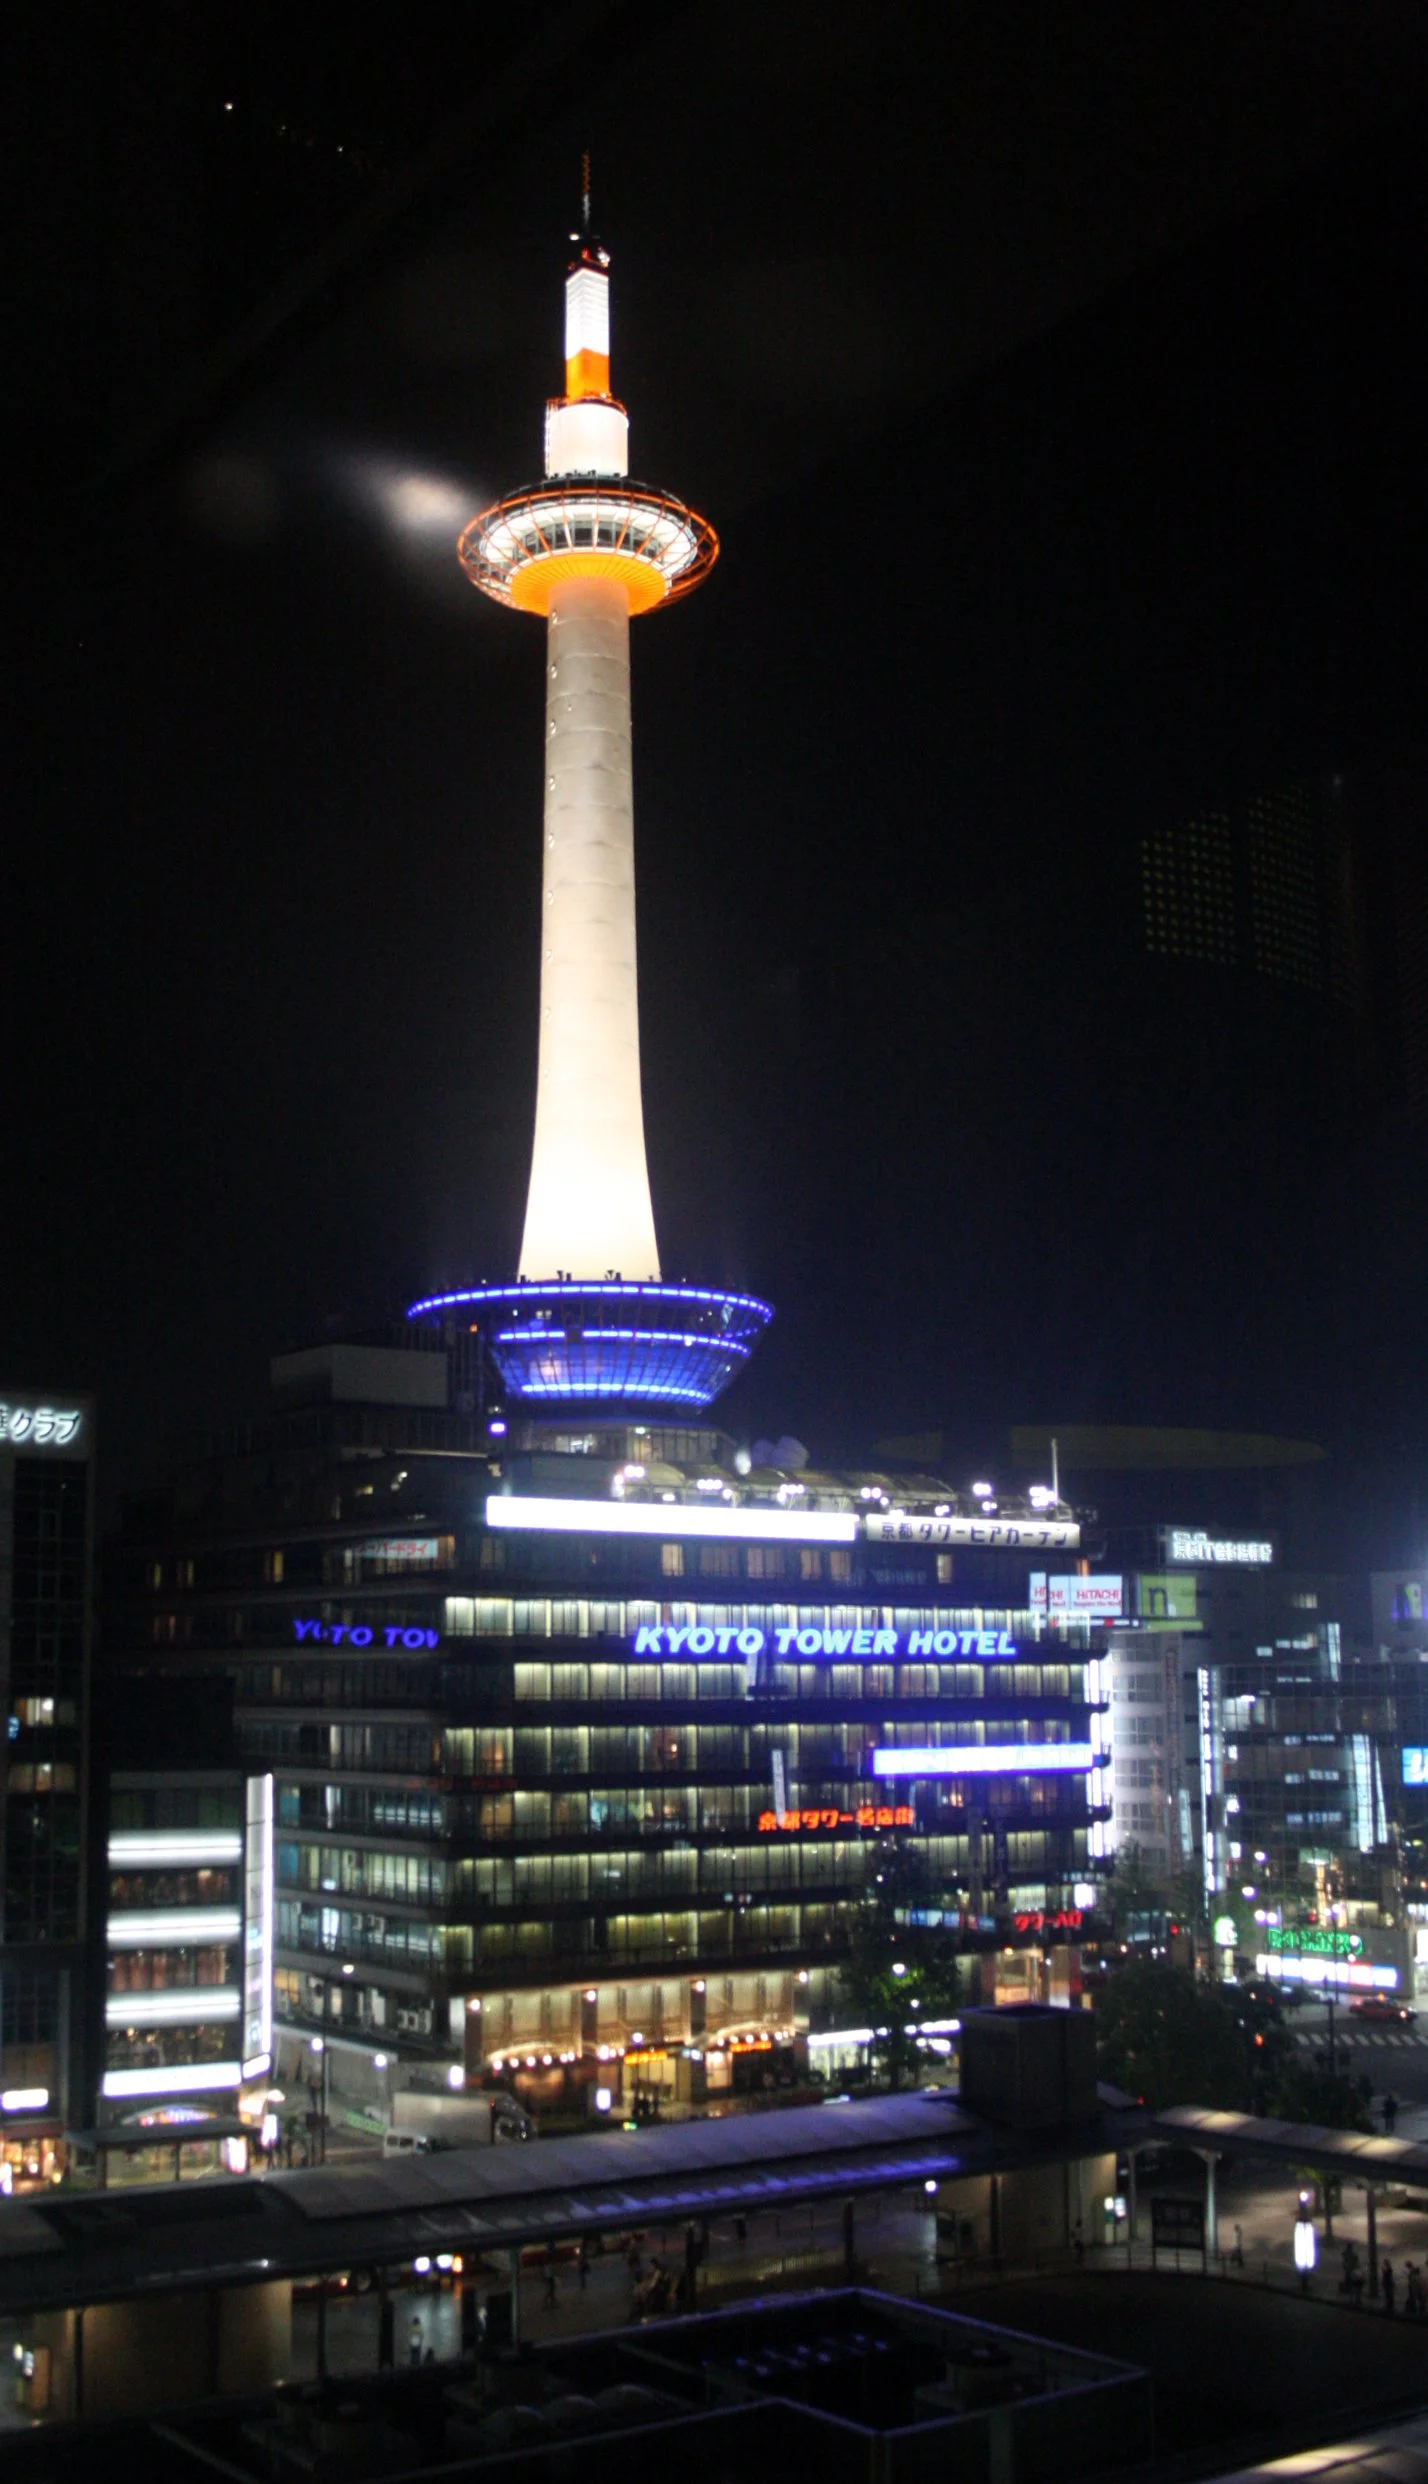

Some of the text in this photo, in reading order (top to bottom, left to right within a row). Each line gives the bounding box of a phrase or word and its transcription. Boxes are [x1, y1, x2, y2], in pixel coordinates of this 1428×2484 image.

[1076, 1588, 1120, 1600] HITACHI
[634, 1626, 1017, 1656] KYOTO TOWER HOTEL
